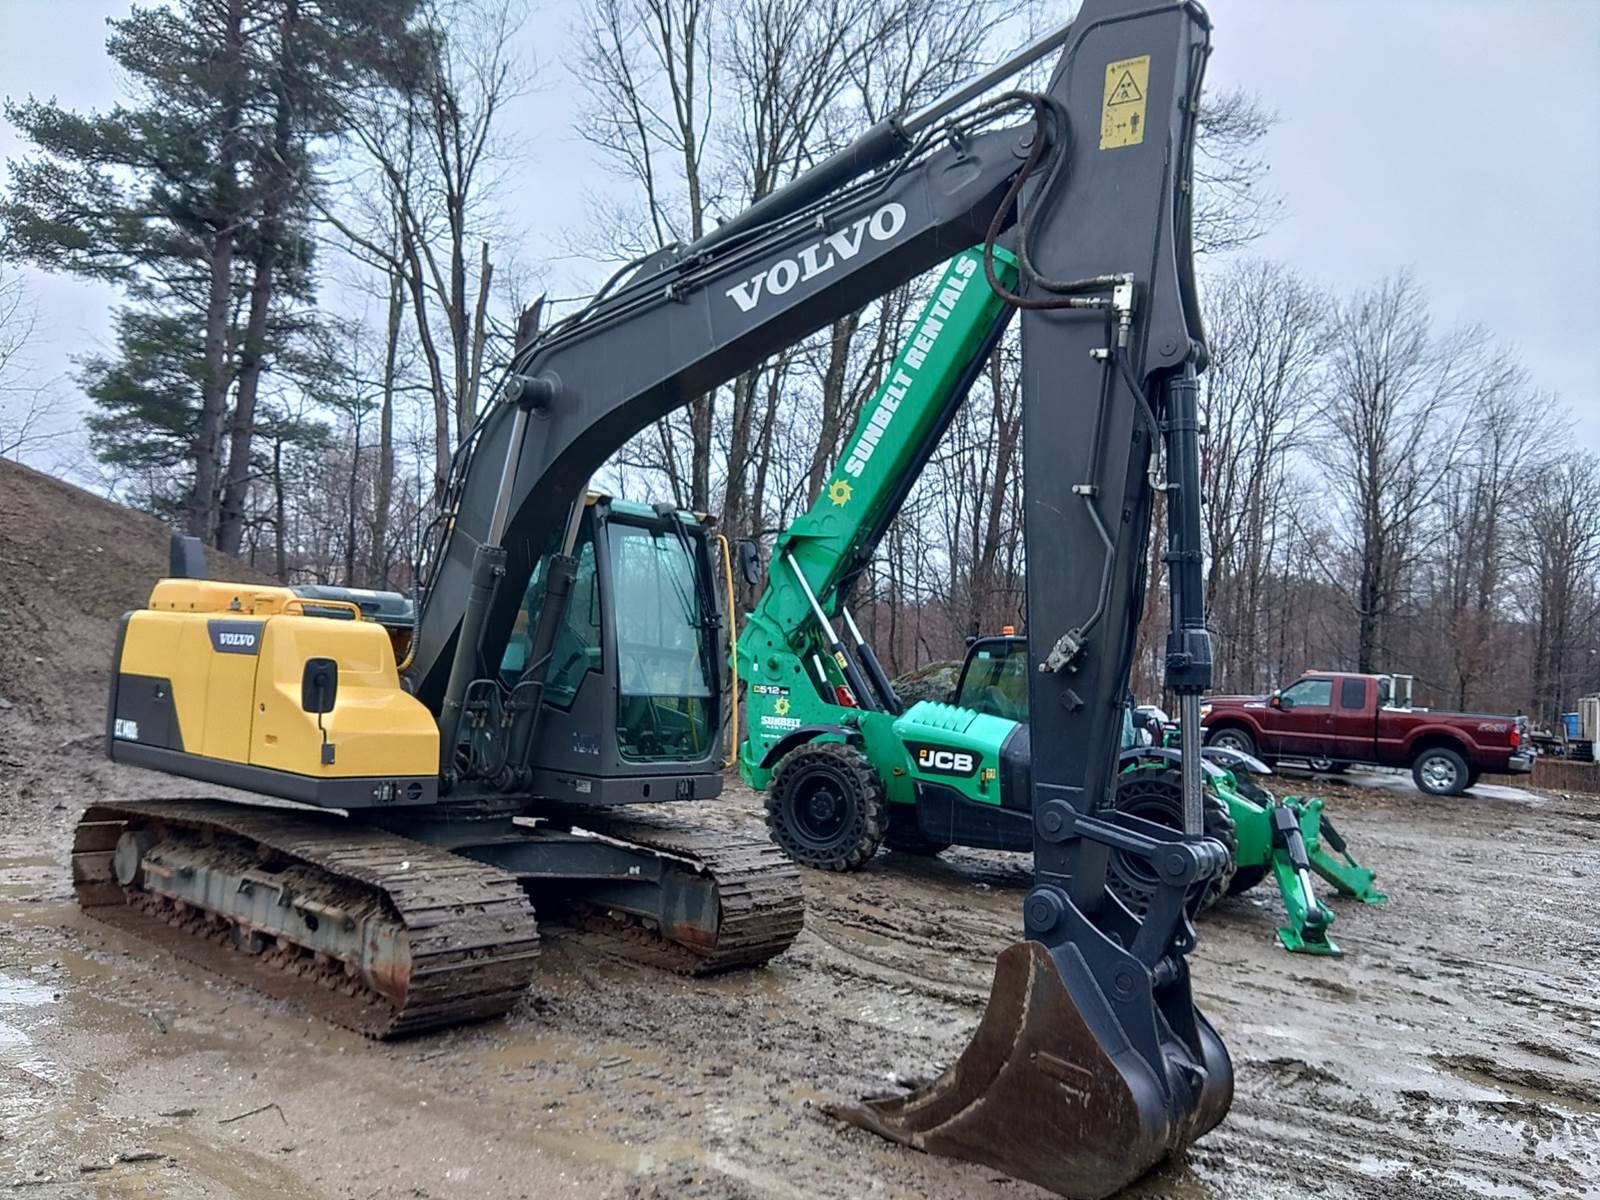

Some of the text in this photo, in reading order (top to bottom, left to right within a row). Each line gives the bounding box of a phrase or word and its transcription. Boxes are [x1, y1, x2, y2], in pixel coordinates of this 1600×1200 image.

[726, 203, 906, 312] VOLVO
[844, 255, 978, 477] SUNBELT RENTALS
[220, 633, 255, 646] VOLVO
[919, 750, 973, 772] JCB
